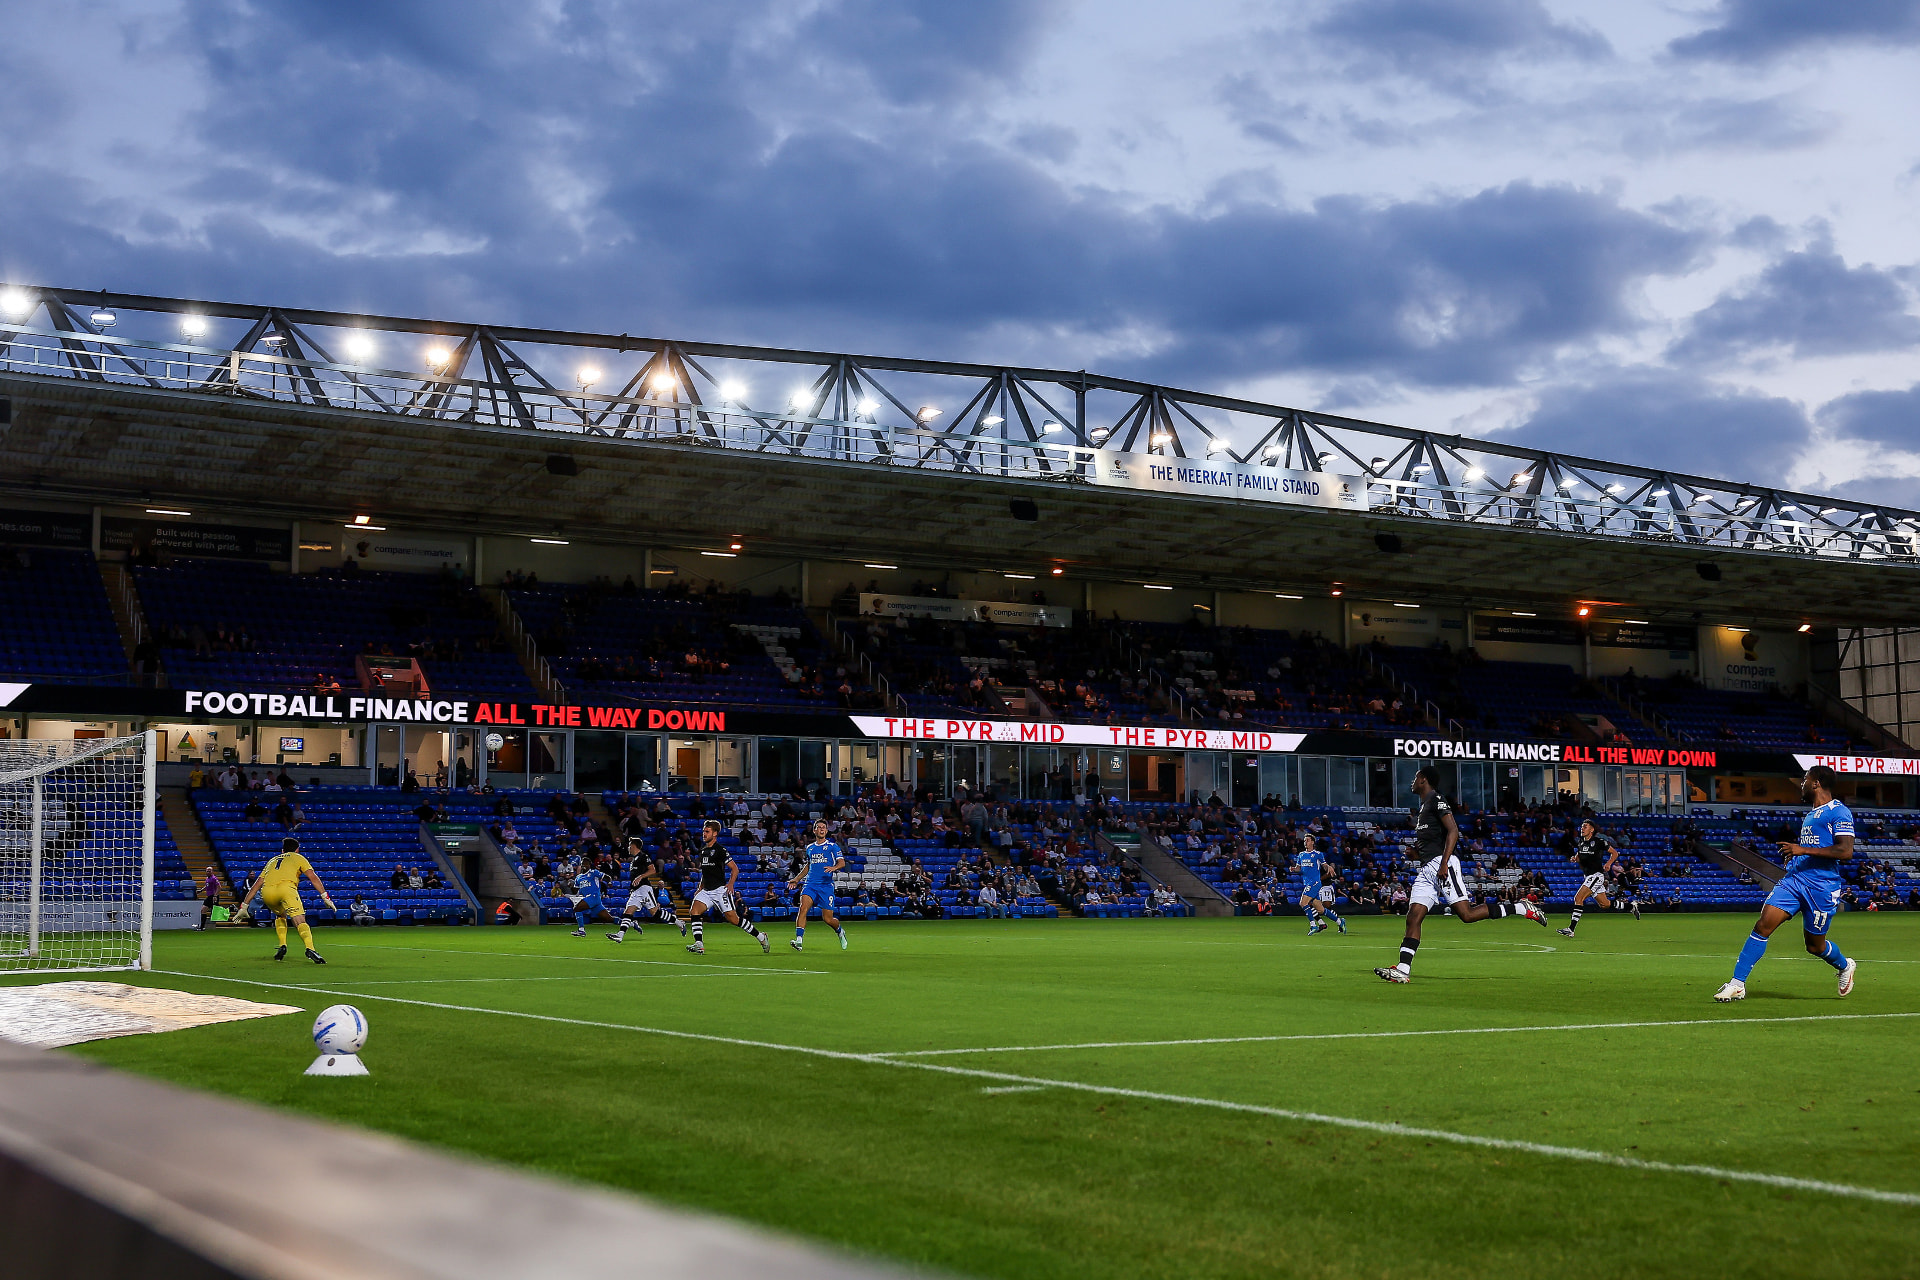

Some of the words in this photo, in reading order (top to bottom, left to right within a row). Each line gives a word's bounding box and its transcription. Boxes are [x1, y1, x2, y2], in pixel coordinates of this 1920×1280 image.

[1150, 465, 1173, 481] THE
[1177, 467, 1233, 487] MEERKAT
[1237, 473, 1278, 491] FAMILY
[1282, 478, 1320, 496] STAND
[156, 528, 177, 537] Built
[180, 529, 200, 538] with
[195, 541, 215, 549] with
[1727, 664, 1776, 677] compare
[185, 690, 343, 718] FOOTBALL
[350, 697, 469, 722] FINANCE
[474, 702, 525, 725] ALL
[531, 704, 581, 727] THE
[588, 706, 642, 728] WAY
[648, 709, 726, 732] DOWN
[884, 718, 935, 739] THE
[1110, 727, 1156, 746] THE
[1393, 738, 1486, 759] FOOTBALL
[1489, 742, 1560, 762] FINANCE
[1563, 745, 1595, 763] ALL
[1597, 747, 1628, 764] THE
[1631, 748, 1664, 765] WAY
[1668, 750, 1717, 767] DOWN
[1815, 756, 1848, 772] THE
